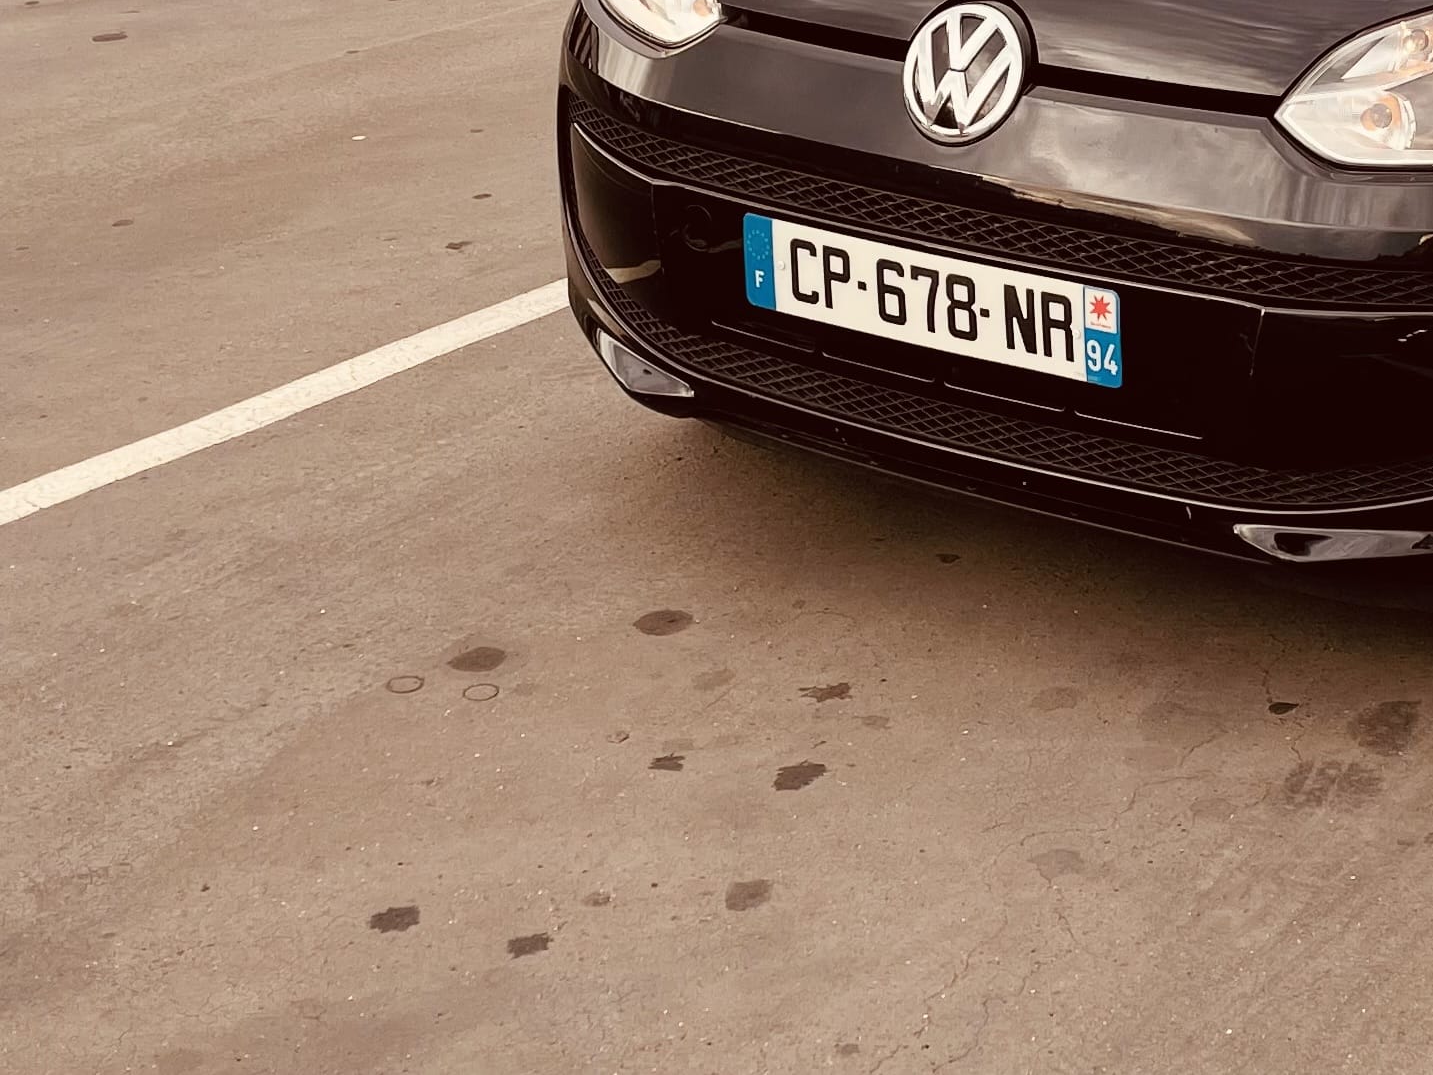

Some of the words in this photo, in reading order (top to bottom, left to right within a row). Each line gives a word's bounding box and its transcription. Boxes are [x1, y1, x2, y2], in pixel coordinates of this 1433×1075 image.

[904, 3, 1023, 137] VW
[754, 269, 765, 288] F
[1086, 339, 1118, 376] 94
